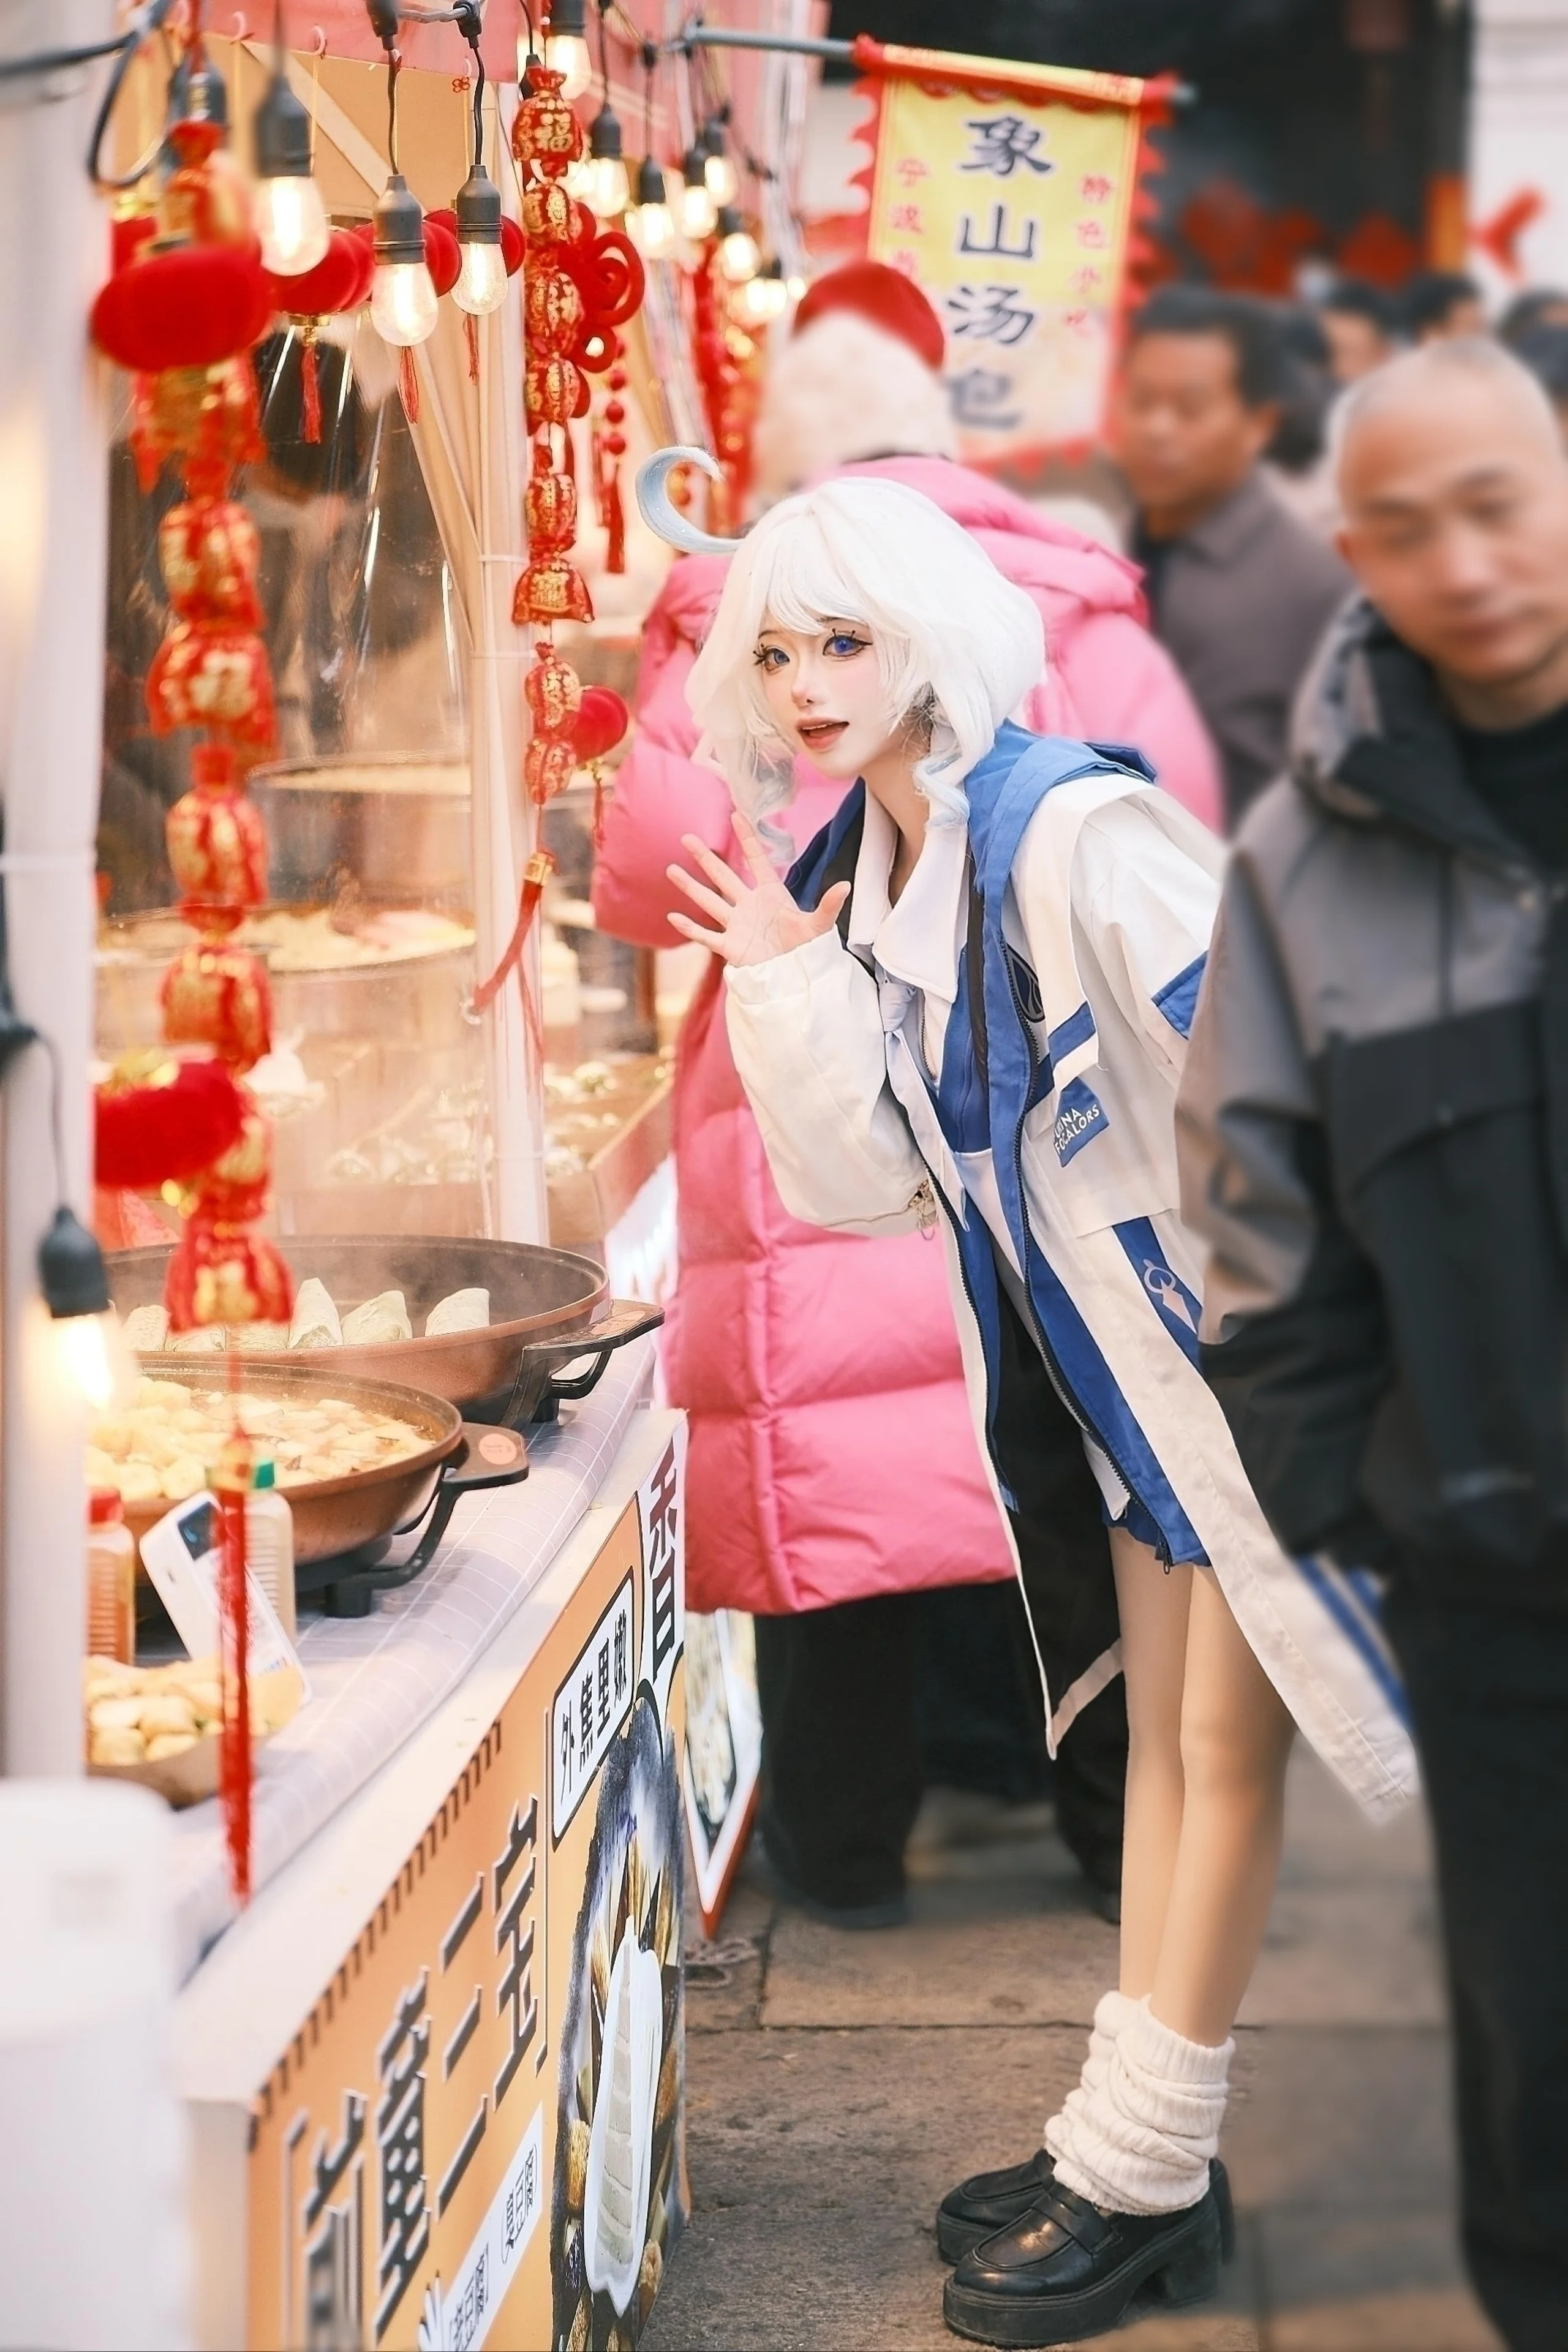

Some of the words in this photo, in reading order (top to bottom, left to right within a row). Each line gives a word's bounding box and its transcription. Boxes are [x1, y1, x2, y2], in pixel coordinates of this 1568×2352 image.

[1055, 1104, 1099, 1155] FOCALORS
[559, 1607, 628, 1804] 外焦里嫩
